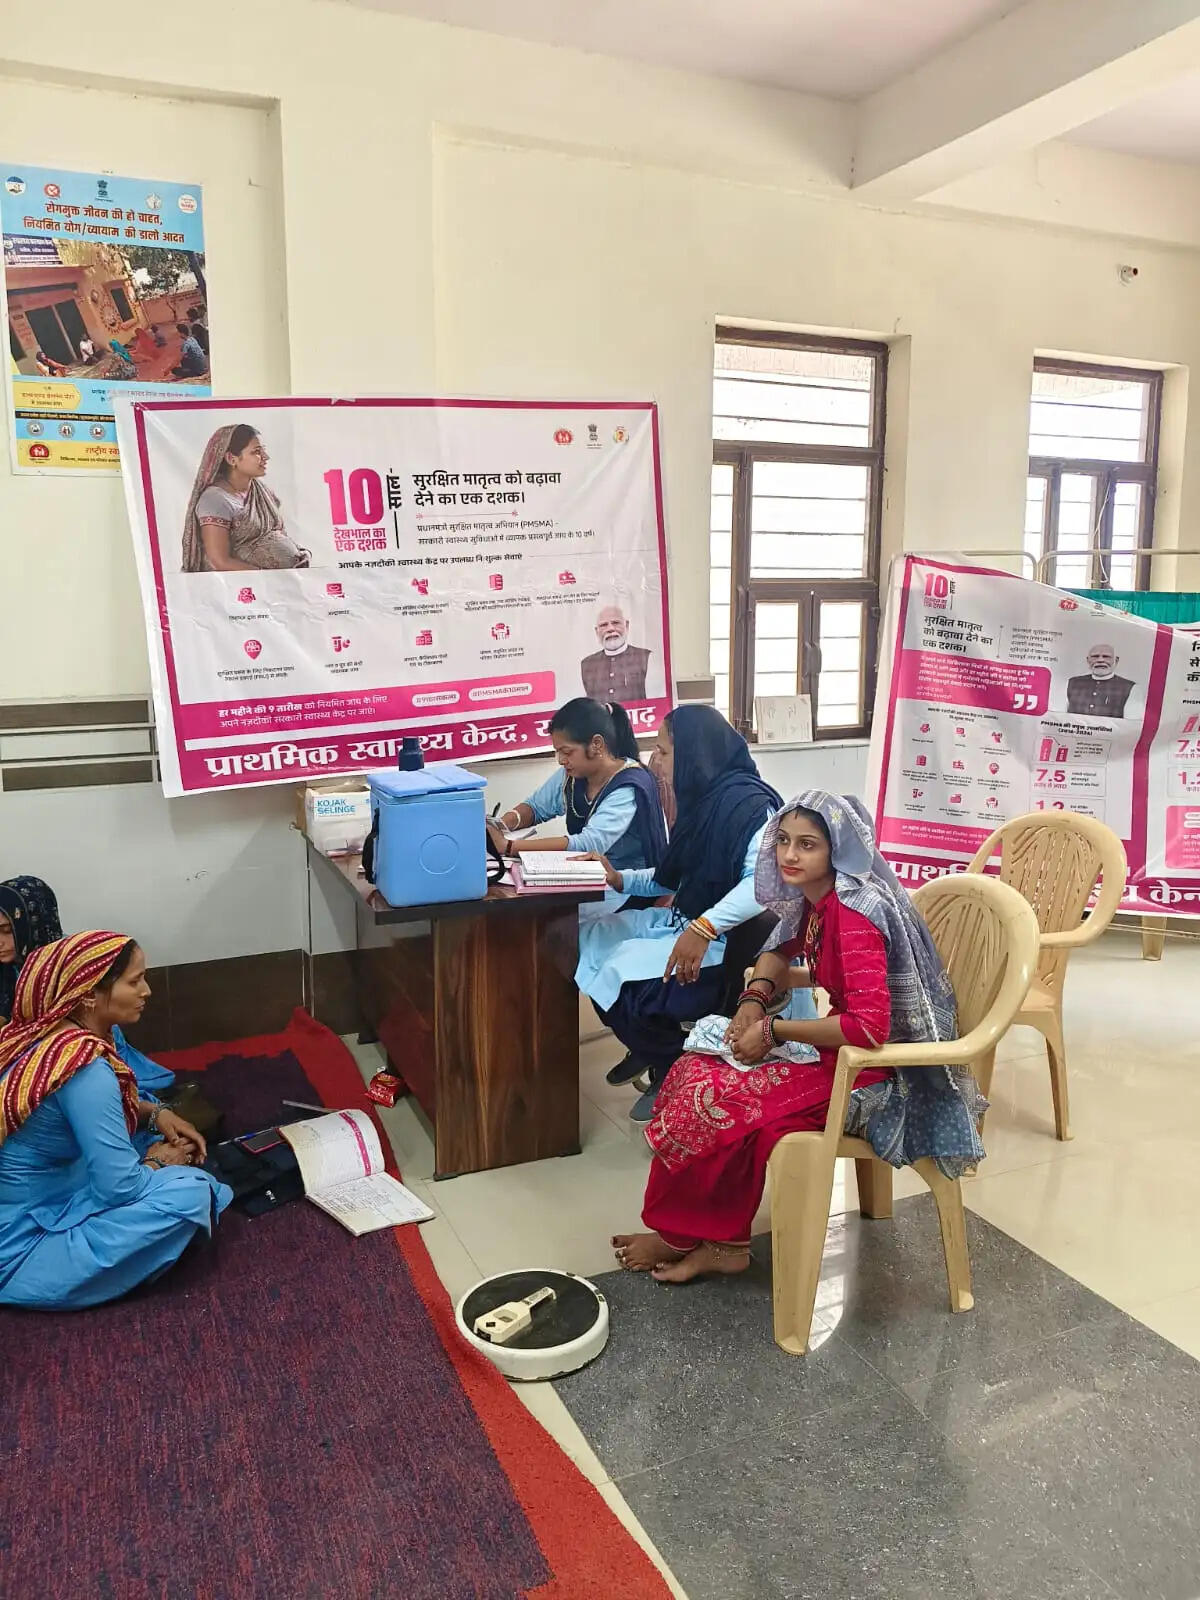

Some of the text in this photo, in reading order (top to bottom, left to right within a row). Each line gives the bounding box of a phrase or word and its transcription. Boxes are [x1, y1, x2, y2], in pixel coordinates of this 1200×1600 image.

[83, 204, 108, 218] जीवन
[112, 207, 123, 221] की
[24, 216, 60, 232] नियमित
[125, 226, 136, 239] की
[162, 231, 185, 243] आदत
[412, 470, 561, 490] सुरक्षित मातृत्व को बढ़ावा
[323, 467, 384, 525] 10
[386, 474, 402, 509] साल
[414, 491, 525, 506] देने का एक दशक।
[333, 527, 386, 539] देखभाल का
[357, 538, 387, 552] दशक
[925, 573, 949, 598] 10
[924, 615, 983, 632] सुरक्षित मातृत्व
[923, 627, 935, 636] को
[966, 632, 979, 642] देने
[981, 636, 993, 645] का
[923, 639, 937, 648] एक
[268, 705, 274, 713] 9
[204, 743, 339, 778] प्राथमिक
[461, 722, 529, 747] केन्द्र,
[1036, 769, 1066, 783] 7.5
[317, 799, 346, 807] KOJAK
